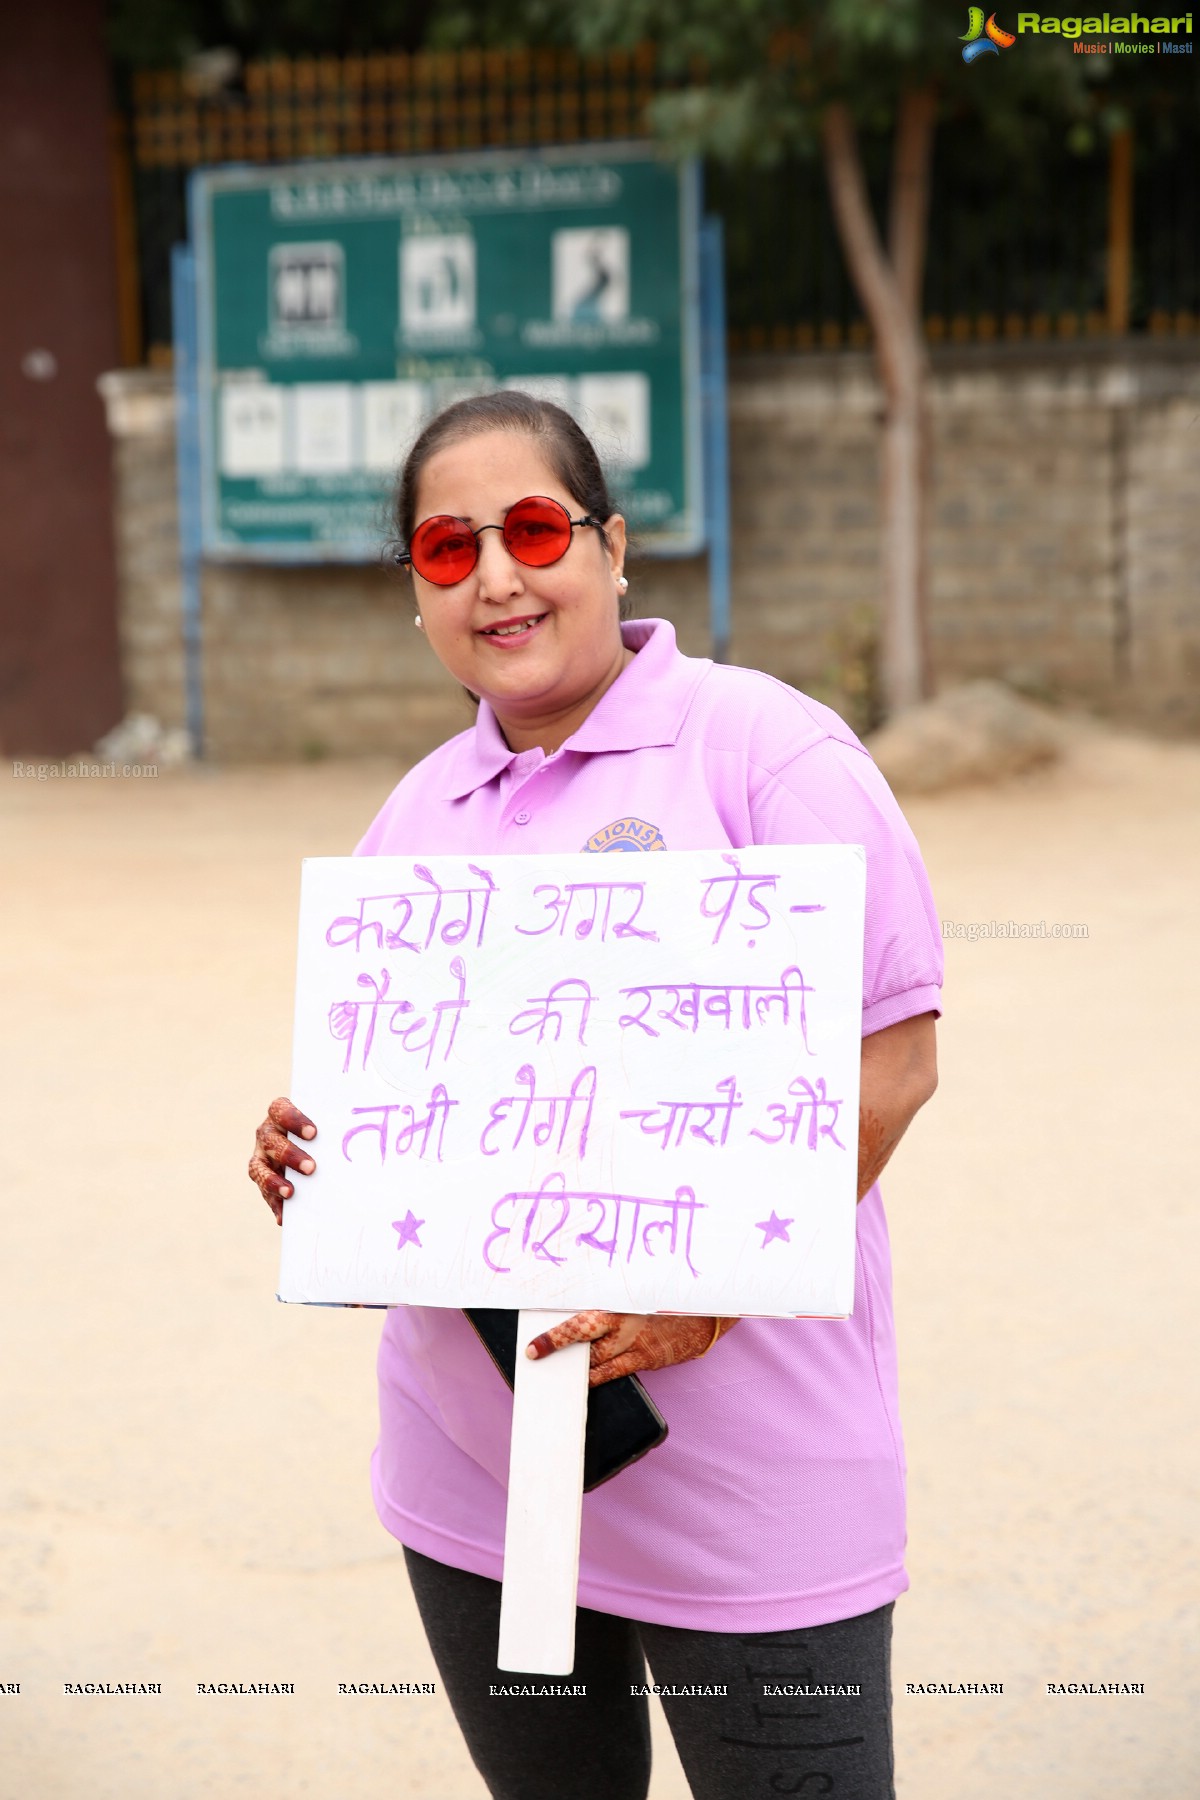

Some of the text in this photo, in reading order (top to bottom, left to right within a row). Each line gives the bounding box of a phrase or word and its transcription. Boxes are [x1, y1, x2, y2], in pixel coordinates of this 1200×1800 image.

[593, 821, 655, 847] LIONS
[326, 863, 500, 954] करोगे
[515, 881, 660, 943] अगर
[509, 978, 600, 1047] की
[618, 965, 818, 1056] रखवाली
[342, 1063, 847, 1166] तभी होगी चारों और
[482, 1171, 709, 1279] हरियाली
